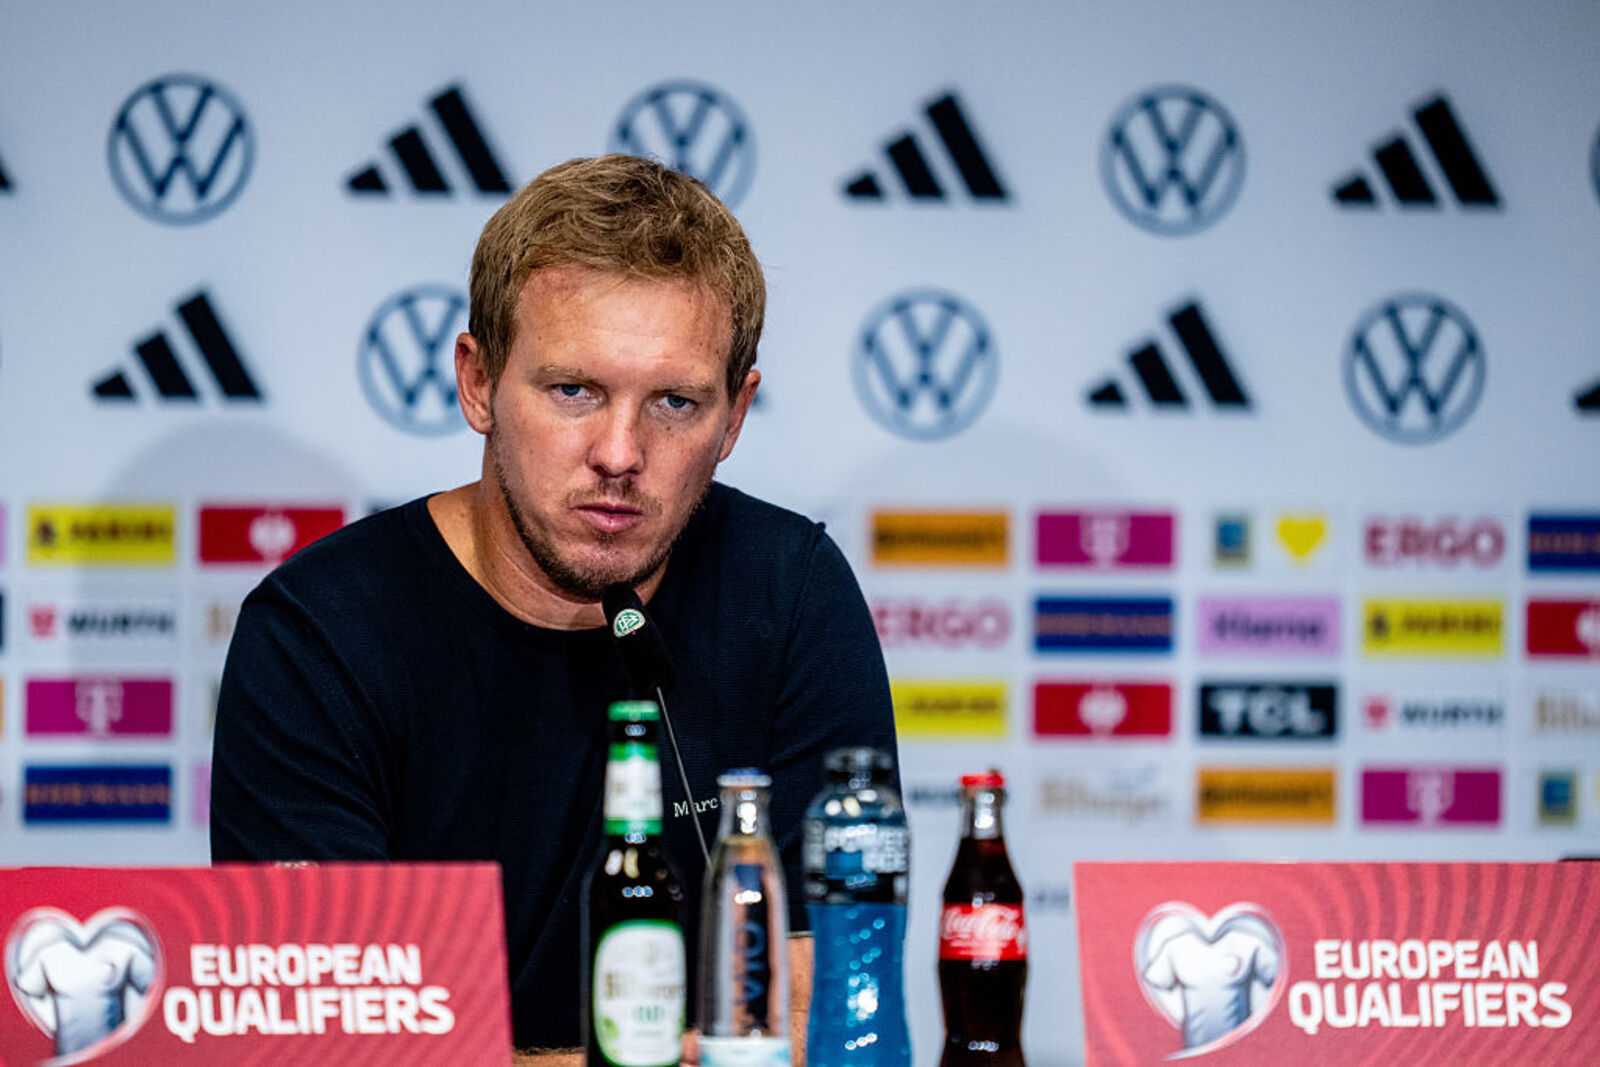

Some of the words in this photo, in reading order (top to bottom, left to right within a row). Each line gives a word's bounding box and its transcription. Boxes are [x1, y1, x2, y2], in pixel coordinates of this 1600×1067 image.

[1365, 518, 1506, 567] ERGO
[1210, 688, 1328, 735] TCL
[190, 943, 421, 987] EUROPEAN
[1314, 939, 1539, 980] EUROPEAN
[163, 986, 456, 1043] QUALIFIERS
[1288, 980, 1573, 1034] QUALIFIERS
